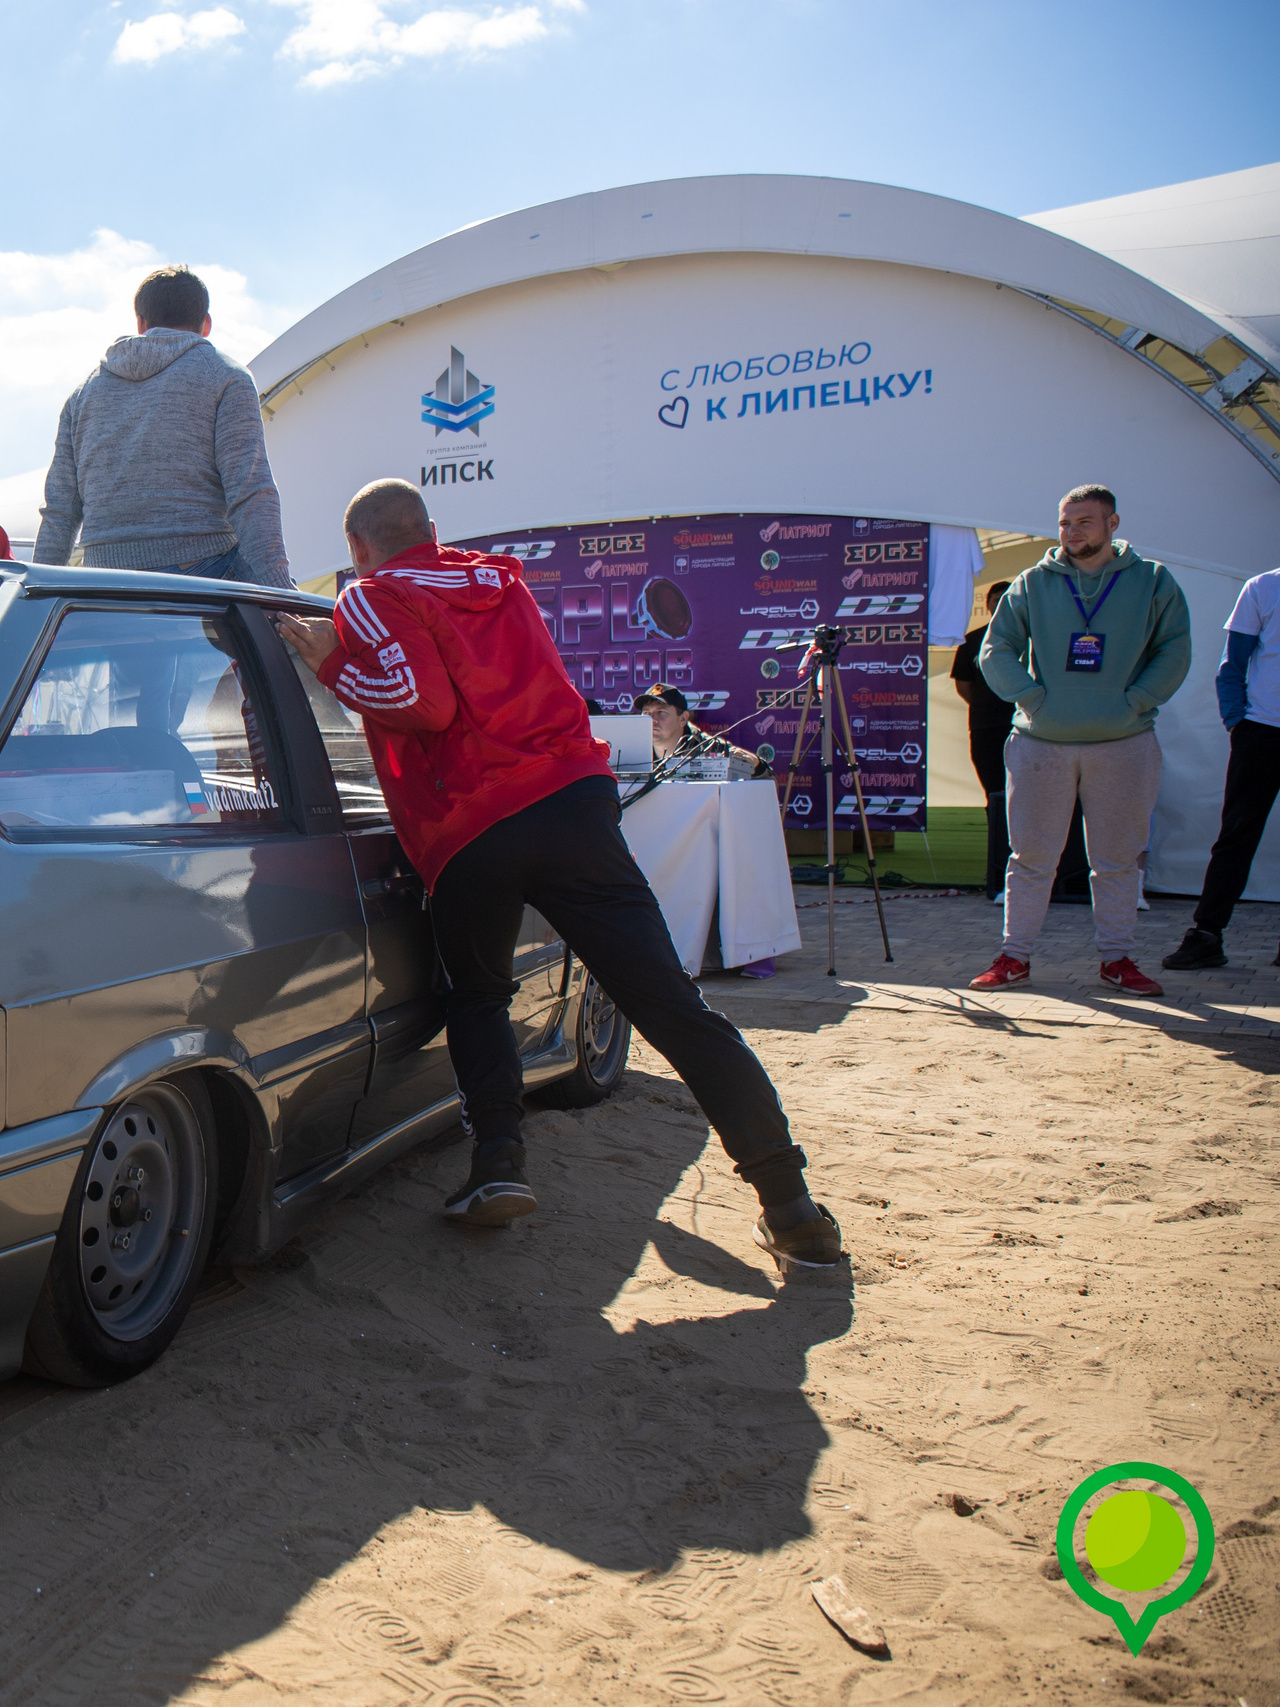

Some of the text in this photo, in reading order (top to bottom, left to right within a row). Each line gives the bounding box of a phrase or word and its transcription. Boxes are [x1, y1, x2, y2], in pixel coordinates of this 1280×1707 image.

[660, 342, 872, 391] С ЛЮБОВЬЮ
[706, 369, 933, 422] К ЛИПЕЦКУ!
[426, 442, 487, 455] группа компаний
[421, 460, 494, 486] ИПСК
[779, 523, 832, 540] ПАТРИОТ
[579, 533, 646, 557] EDGE
[844, 540, 923, 565] EDGE
[602, 562, 649, 577] ПАТРИОТ
[862, 571, 919, 588] ПАТРИОТ
[844, 623, 923, 645] EDGE
[559, 648, 693, 689] ТРОВ
[774, 721, 821, 734] ПАТИО
[861, 773, 917, 787] ПАТРИОТ
